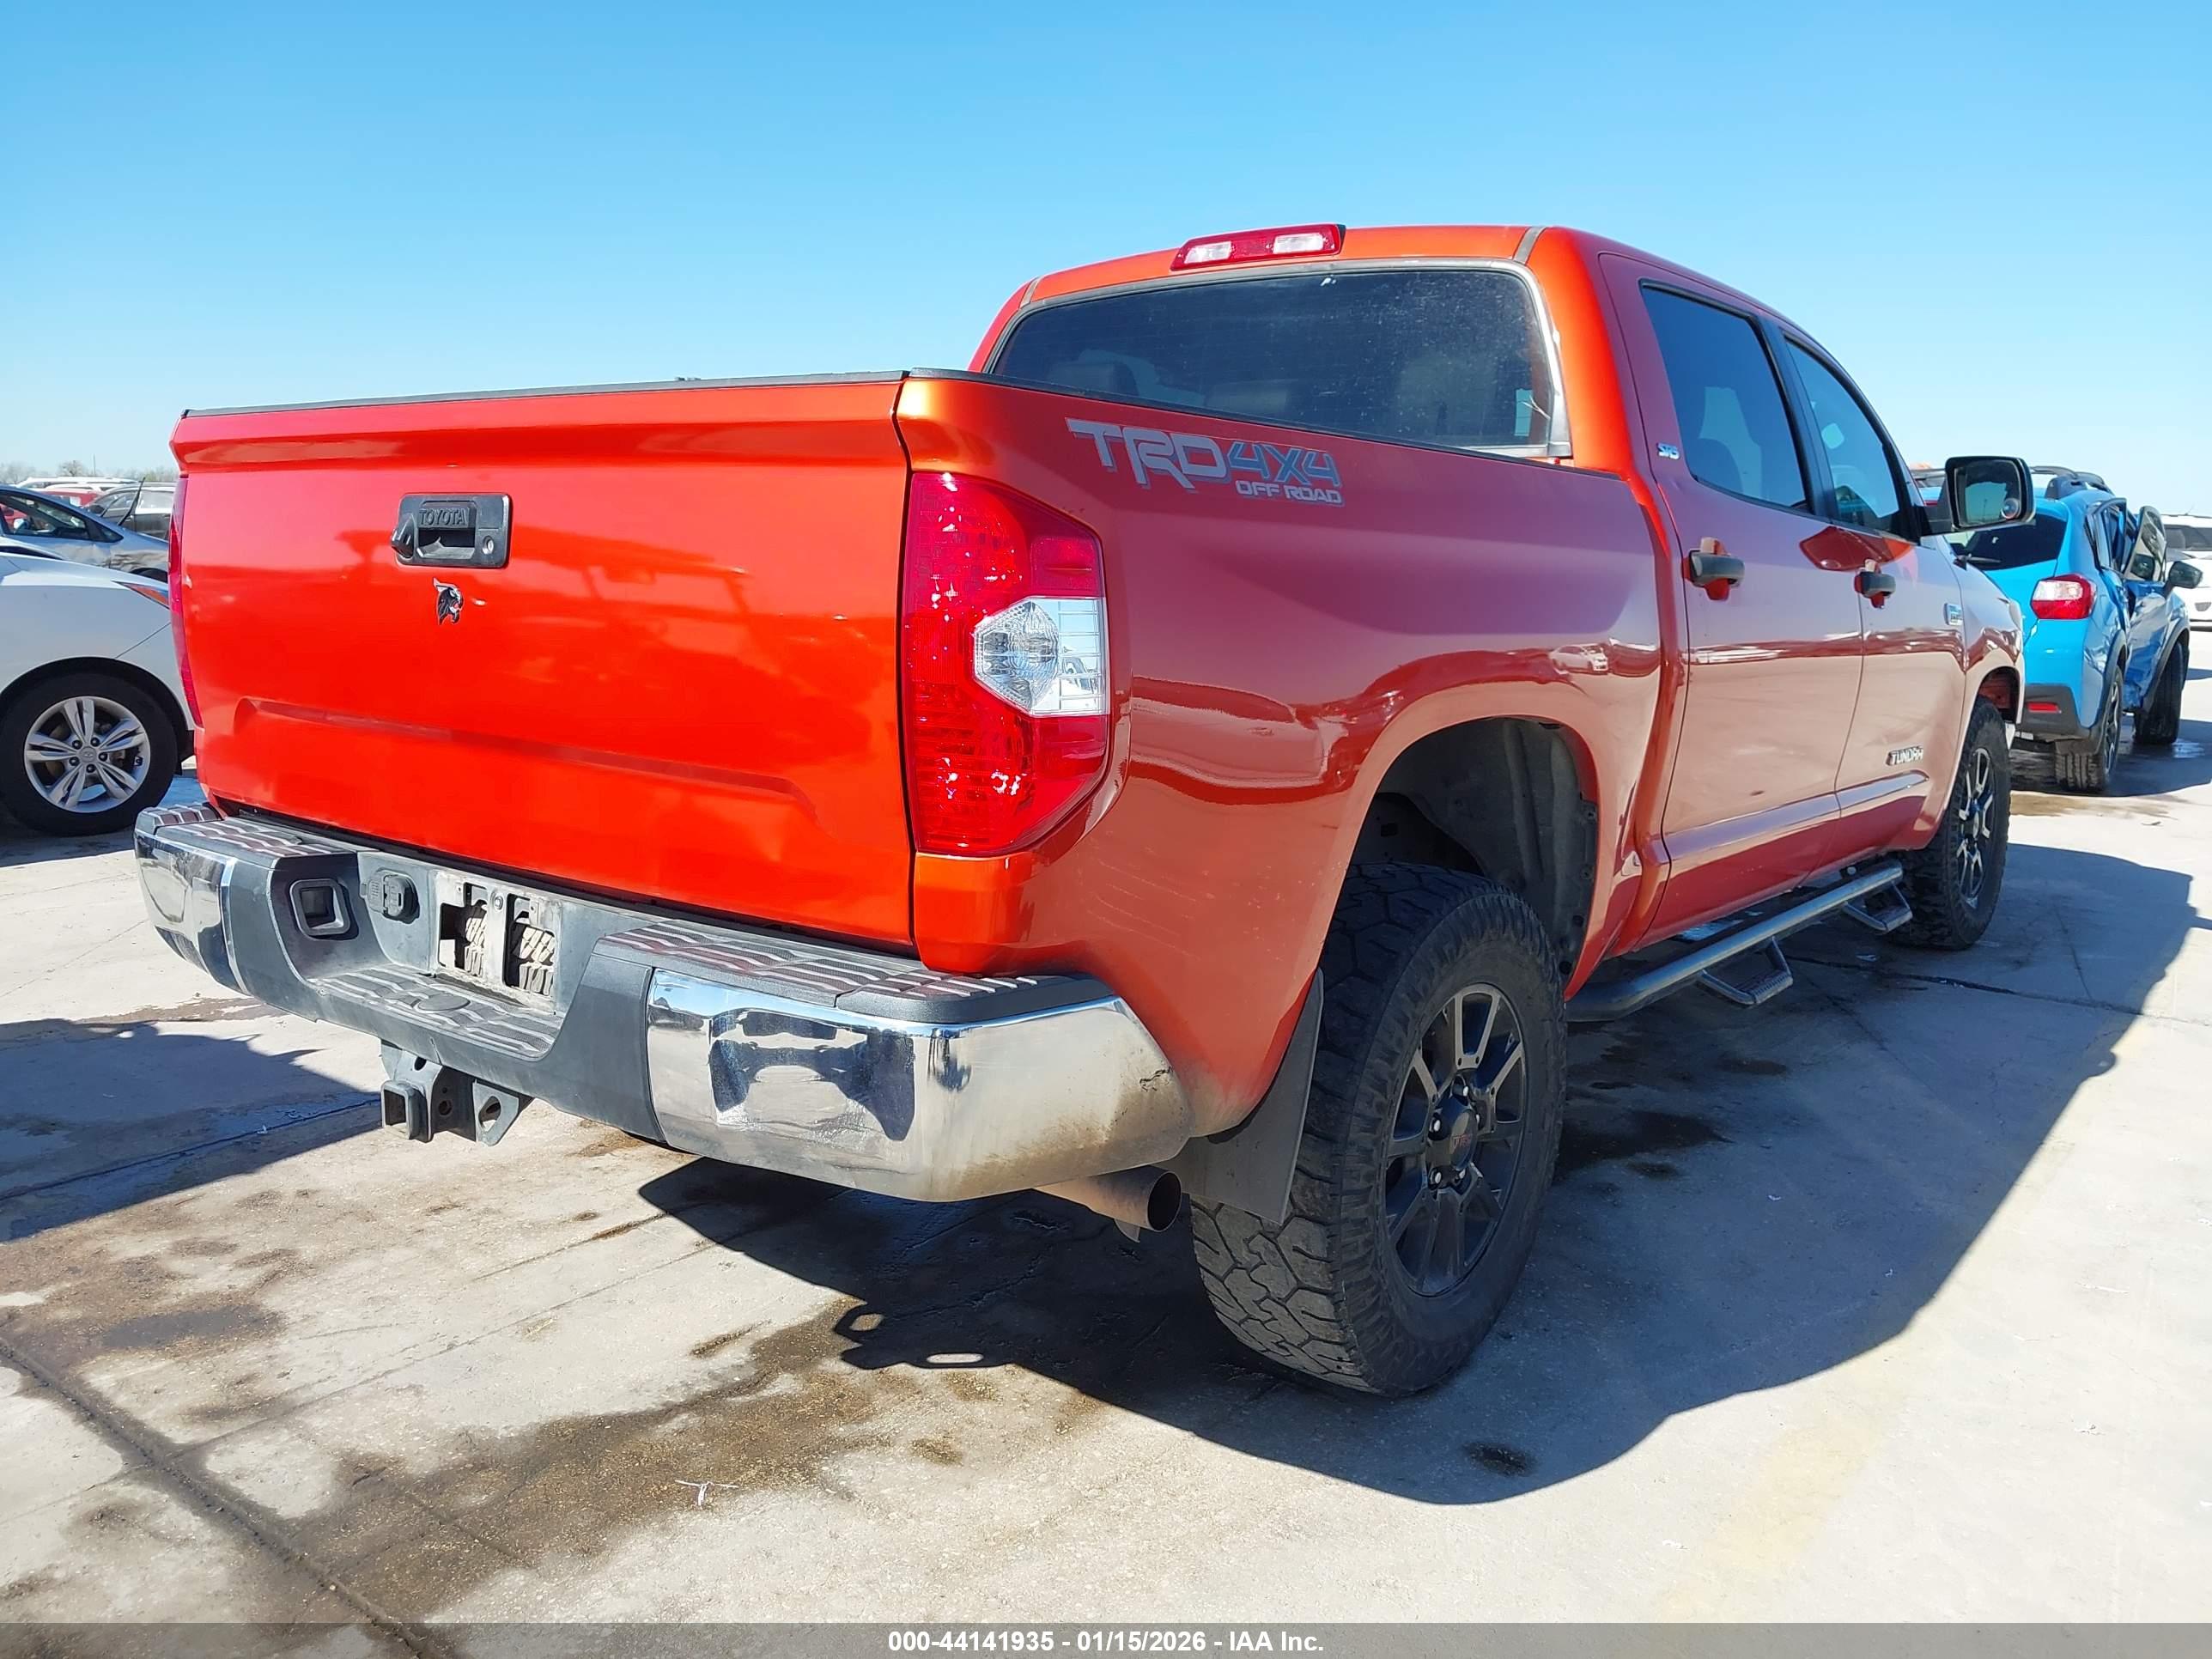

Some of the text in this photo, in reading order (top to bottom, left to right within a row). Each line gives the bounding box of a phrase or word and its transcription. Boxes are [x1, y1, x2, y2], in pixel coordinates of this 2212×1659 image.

[1066, 417, 1228, 491] TRD
[1236, 480, 1342, 504] OFF ROAD
[419, 507, 468, 526] TOYOTA
